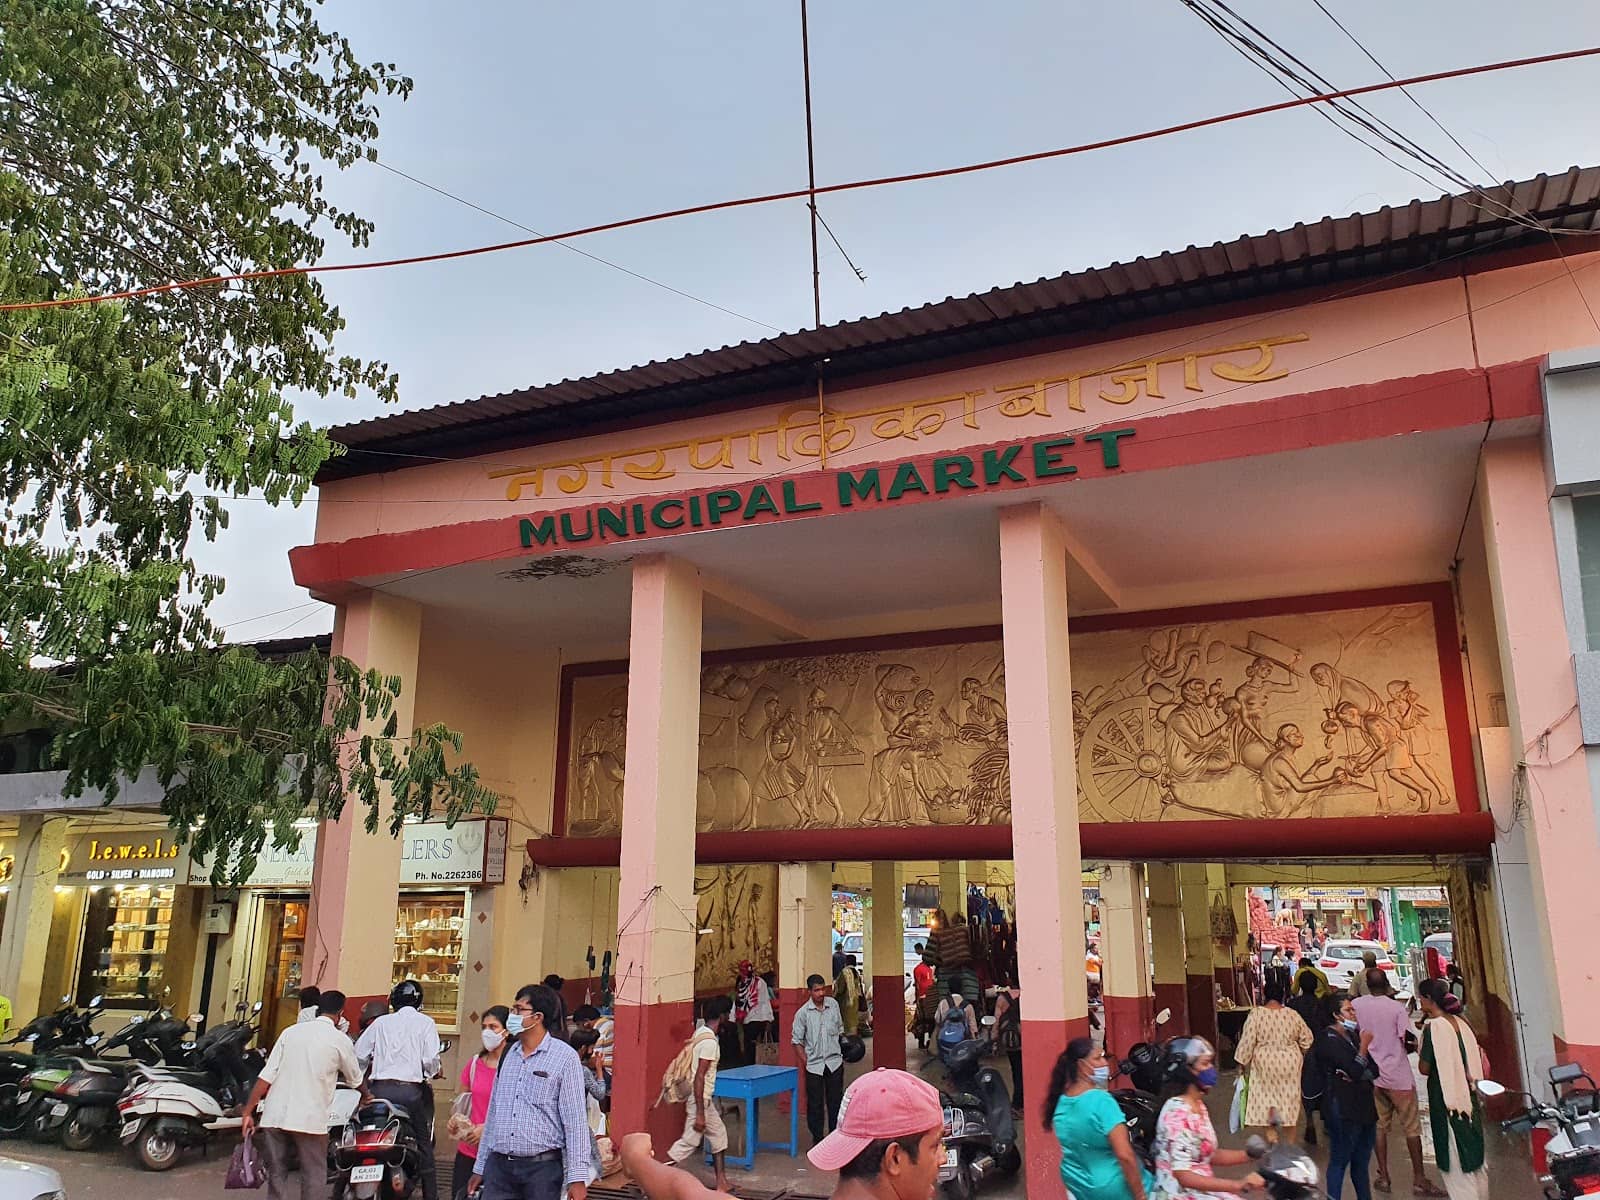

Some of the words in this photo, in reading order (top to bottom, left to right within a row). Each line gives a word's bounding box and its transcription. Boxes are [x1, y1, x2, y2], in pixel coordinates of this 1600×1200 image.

[519, 479, 822, 547] MUNICIPAL
[836, 427, 1136, 506] MARKET
[86, 869, 105, 880] GOLD
[110, 868, 133, 879] SILVER
[139, 867, 176, 879] DIAMONDS
[190, 874, 208, 882] Shop
